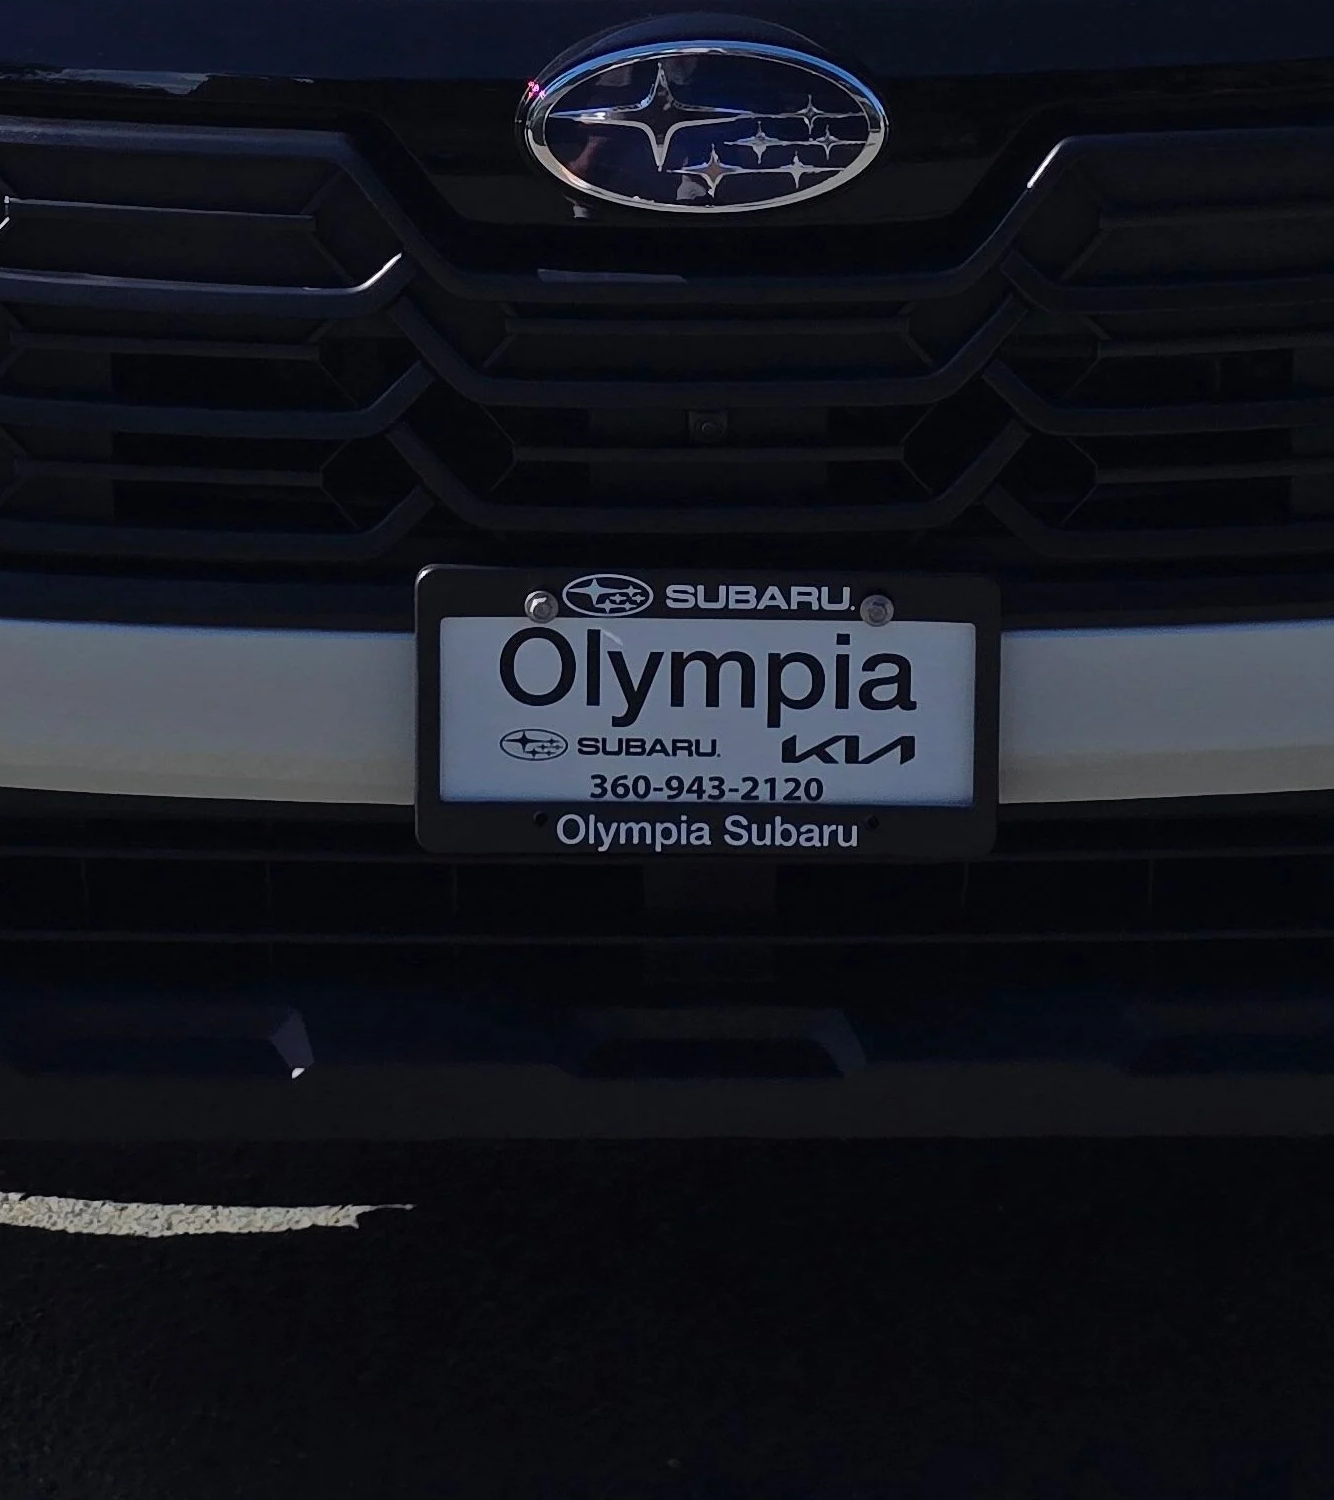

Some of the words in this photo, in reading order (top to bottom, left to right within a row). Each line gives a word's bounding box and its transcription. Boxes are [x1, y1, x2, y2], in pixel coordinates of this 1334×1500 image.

[499, 626, 918, 729] Olympia
[590, 773, 824, 801] 360-943-2120
[556, 813, 712, 852] Olympia
[723, 815, 858, 848] Subaru
